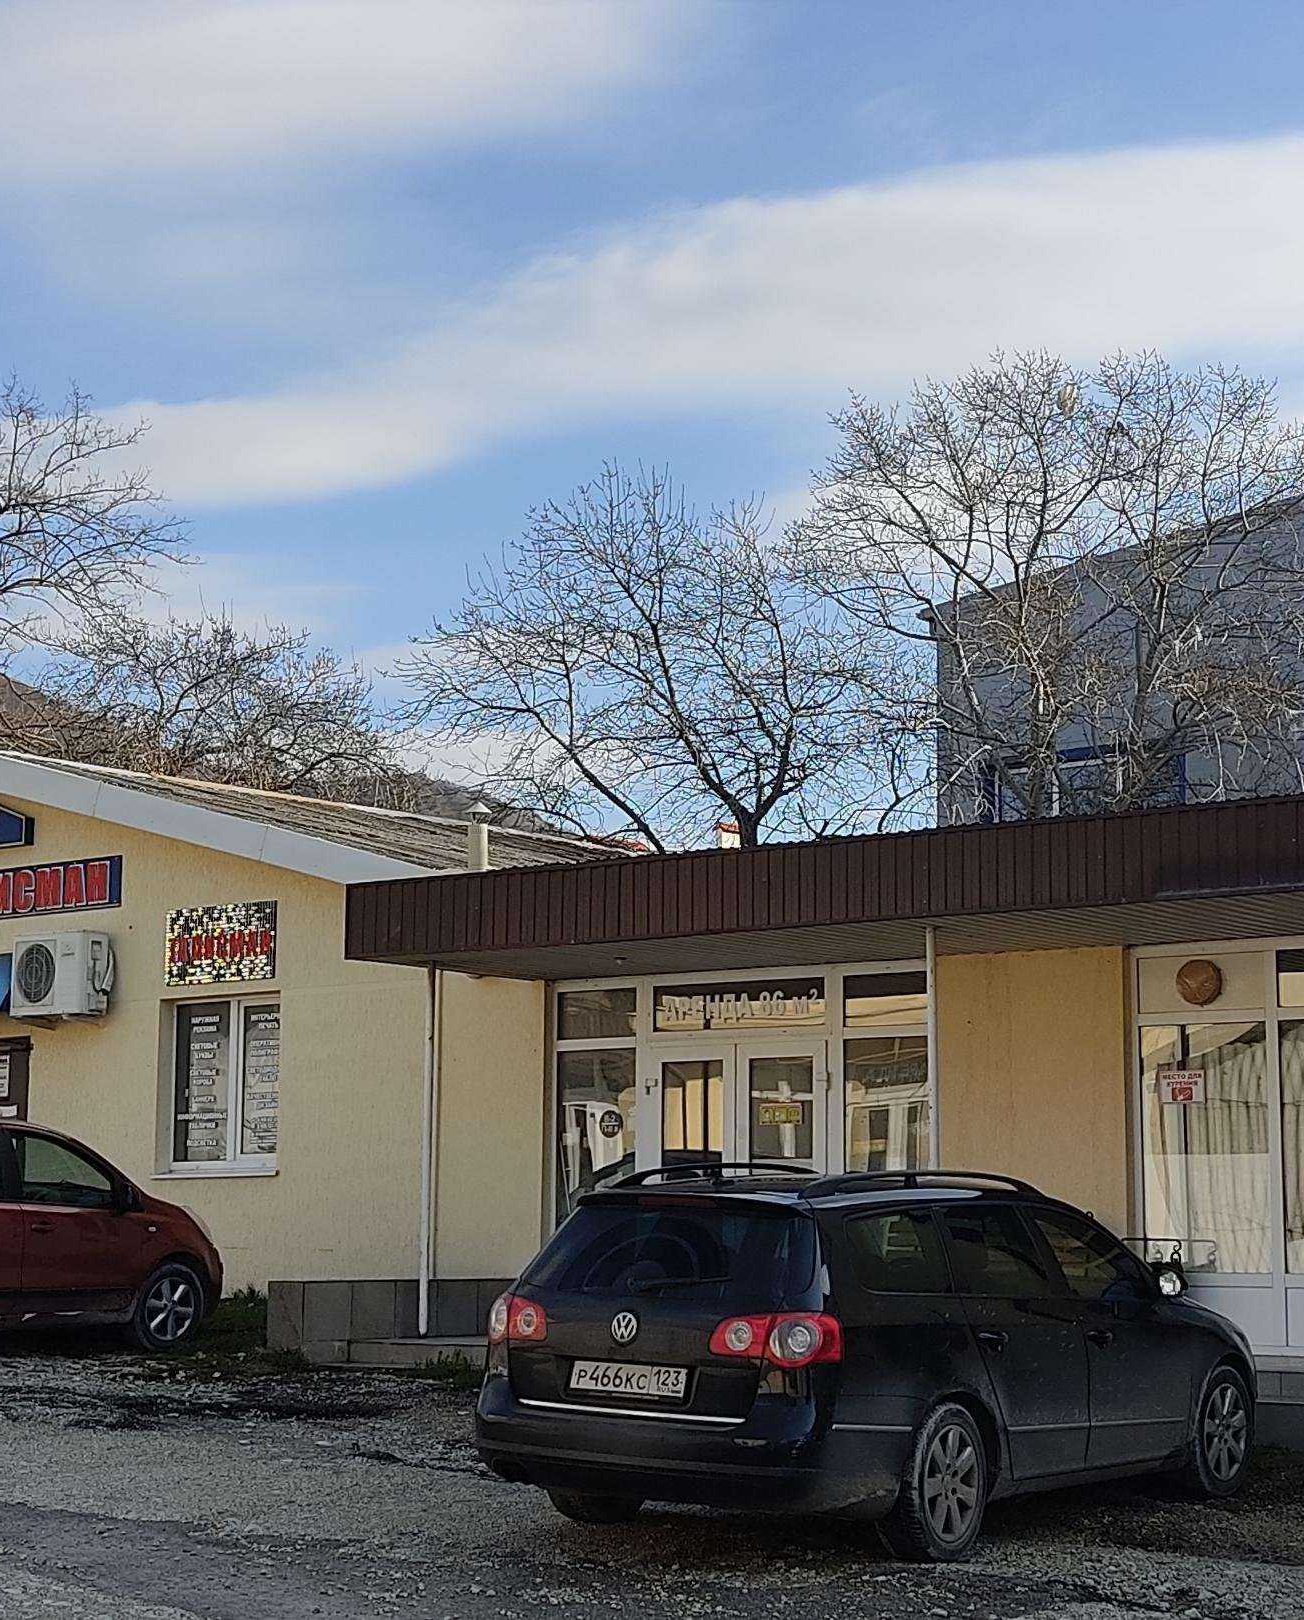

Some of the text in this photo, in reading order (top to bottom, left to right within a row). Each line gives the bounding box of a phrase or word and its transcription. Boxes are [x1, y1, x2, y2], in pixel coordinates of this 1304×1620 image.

[663, 993, 754, 1023] АРЕНДА
[759, 990, 785, 1015] 86
[654, 1369, 682, 1387] 123
